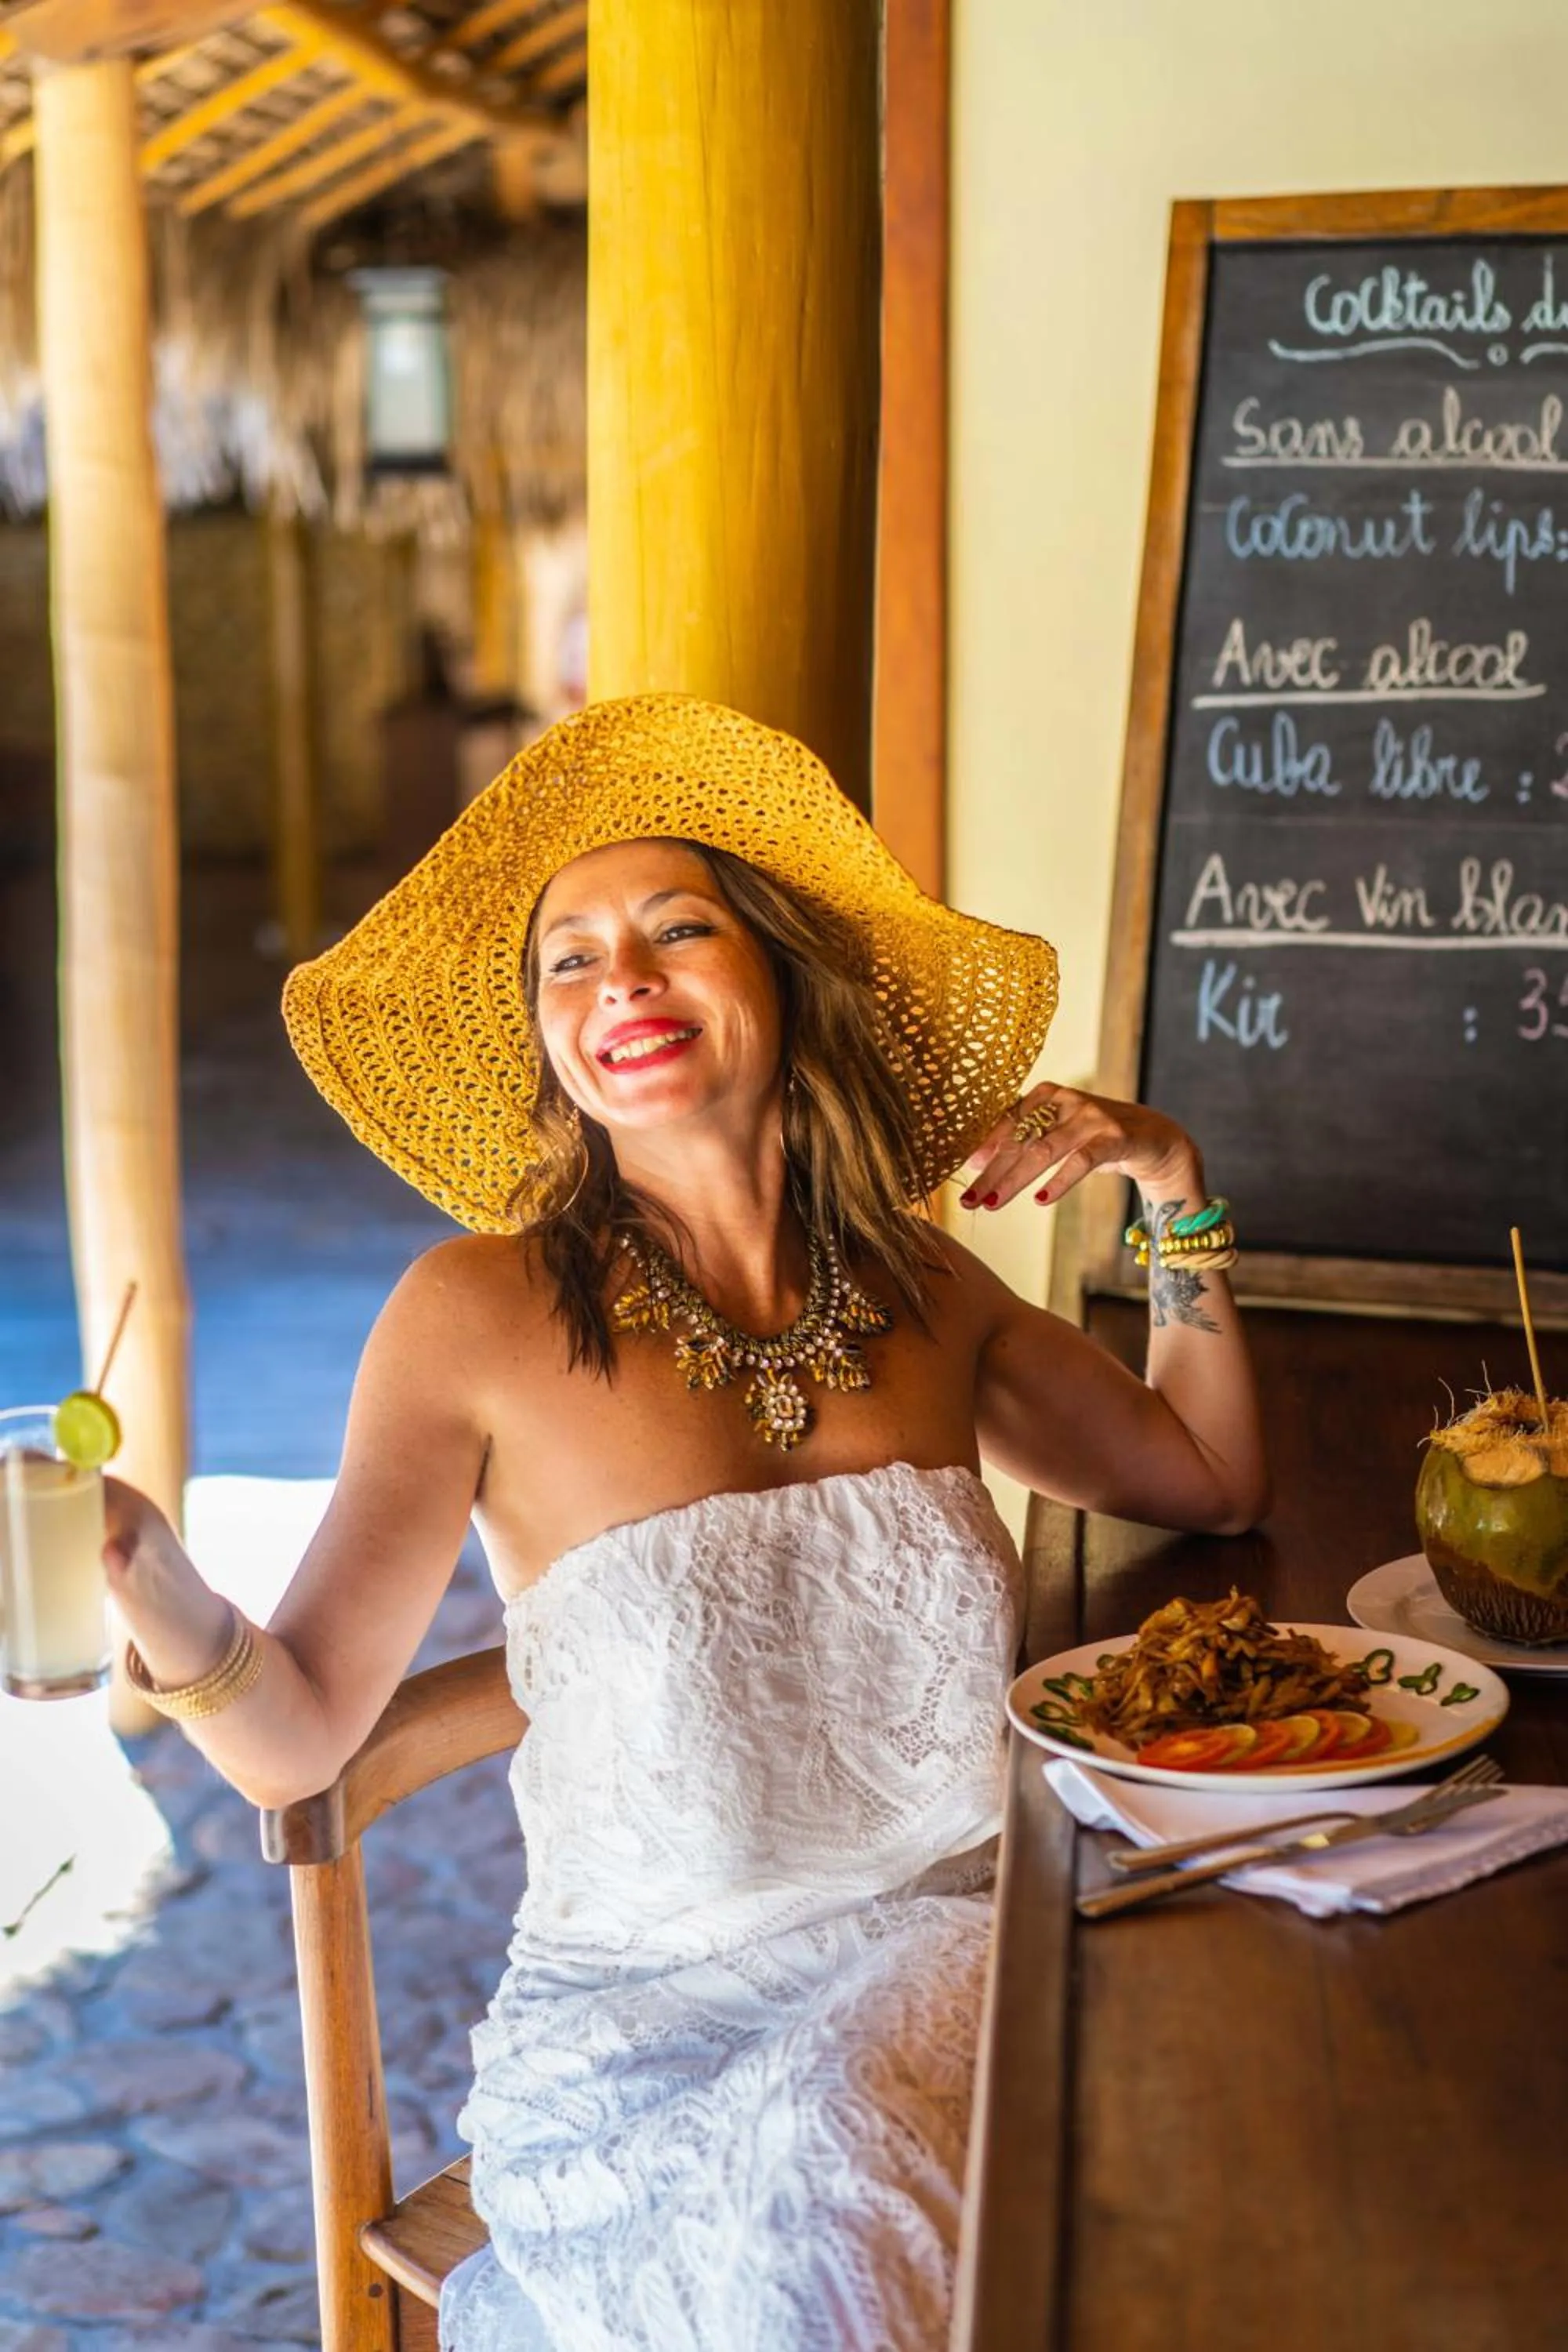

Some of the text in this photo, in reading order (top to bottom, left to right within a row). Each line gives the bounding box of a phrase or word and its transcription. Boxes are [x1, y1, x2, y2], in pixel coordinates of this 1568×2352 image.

[1232, 385, 1563, 459] Sans alcool
[1212, 617, 1530, 690] Avec alcool
[1207, 710, 1342, 797] Cuba
[1370, 717, 1488, 802] libre
[1185, 852, 1330, 932] Avec
[1196, 959, 1290, 1048] Kir
